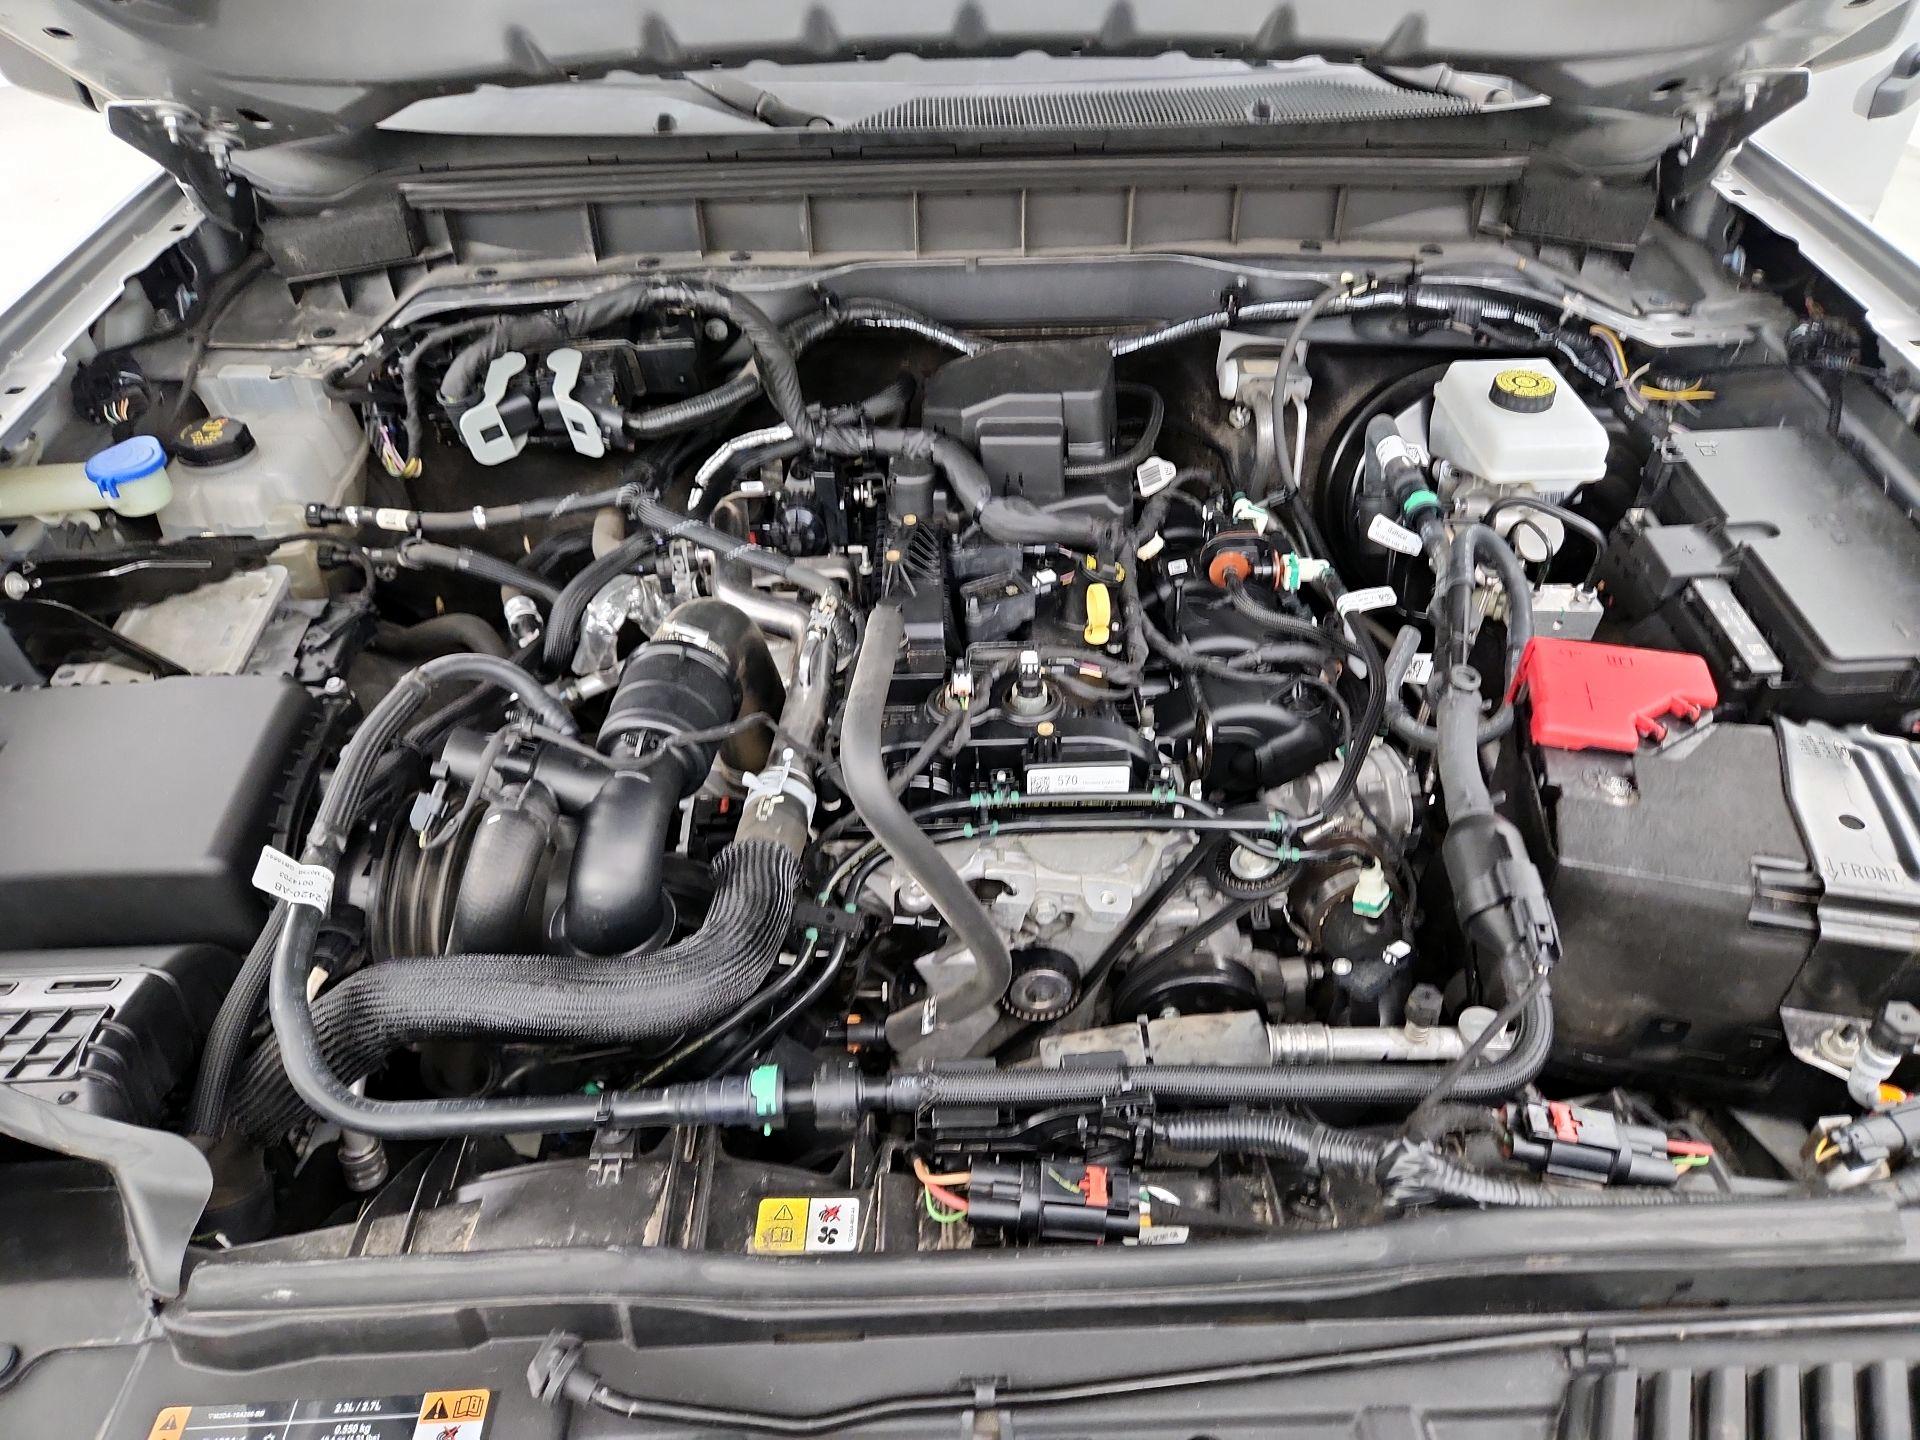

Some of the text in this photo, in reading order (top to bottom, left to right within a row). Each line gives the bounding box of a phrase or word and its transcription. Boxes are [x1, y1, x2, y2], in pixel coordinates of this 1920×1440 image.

[1057, 774, 1078, 786] 570
[1840, 862, 1899, 884] FRONT
[334, 1401, 355, 1414] 2.3L
[361, 1399, 382, 1412] 2.7L
